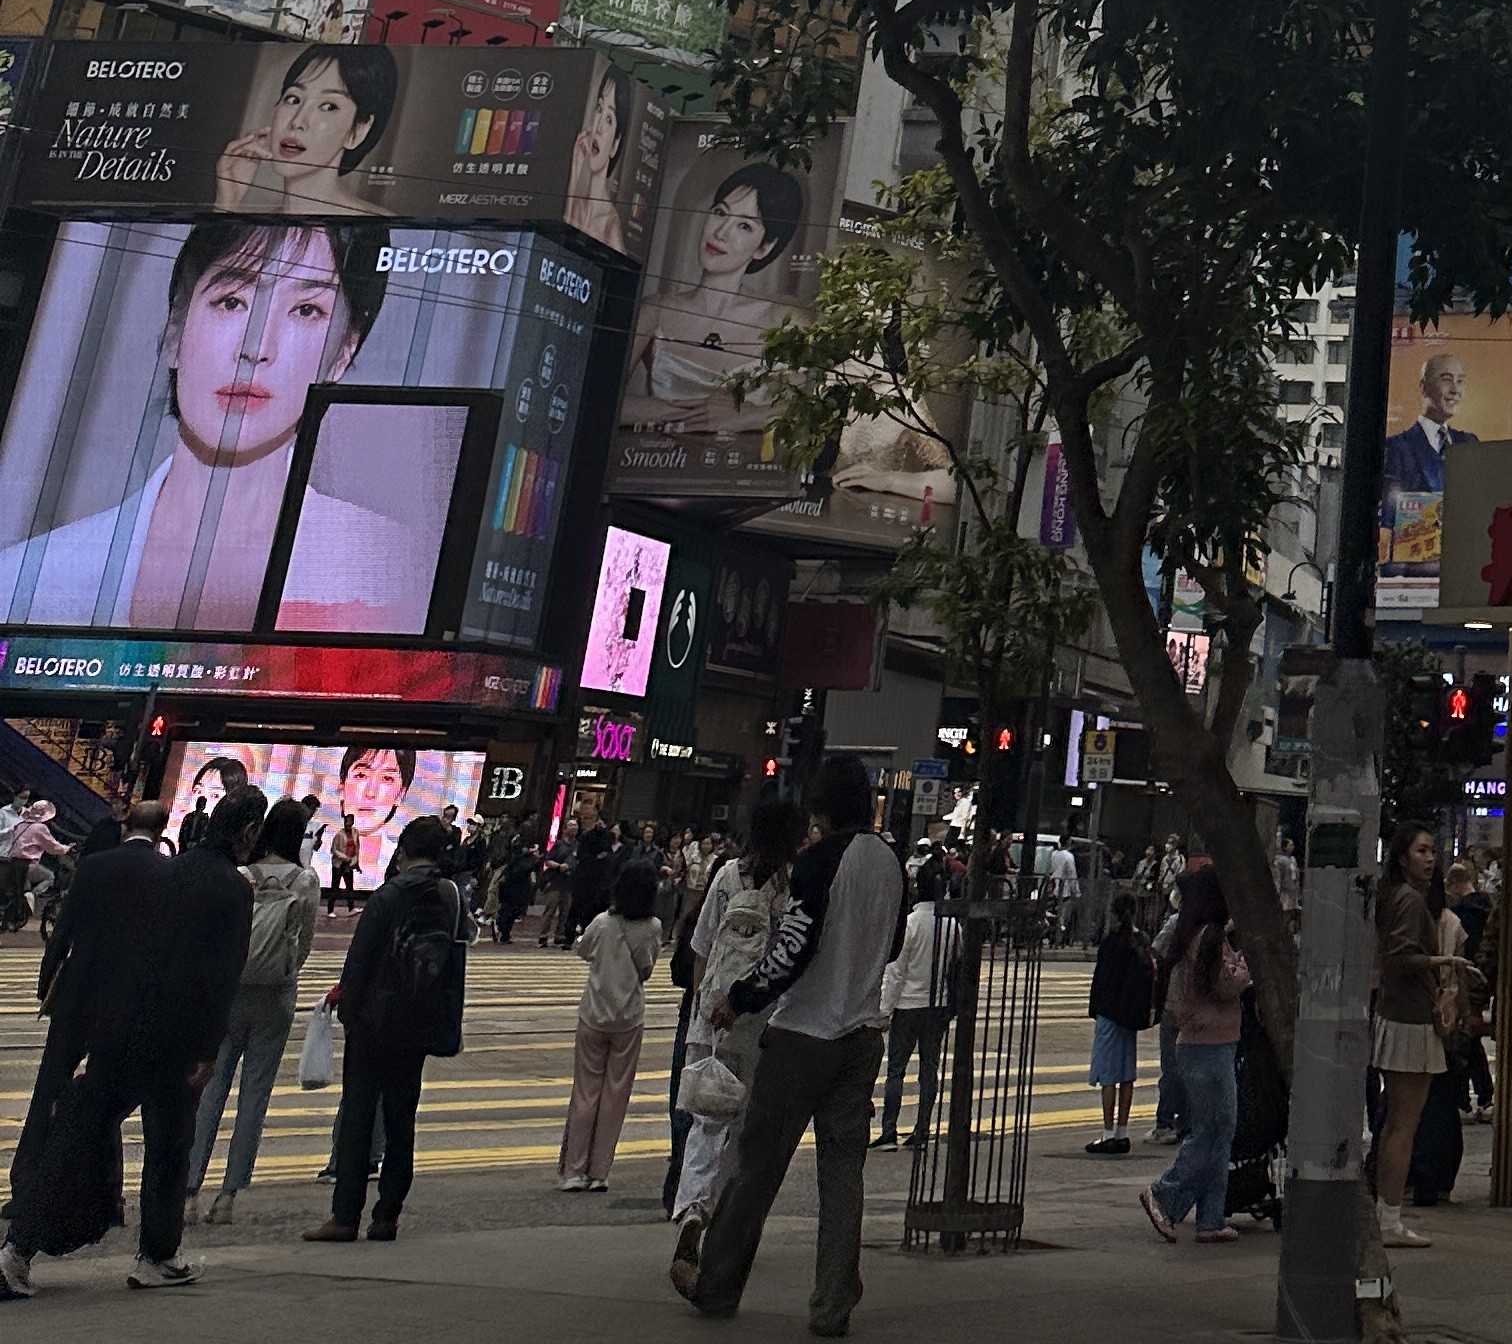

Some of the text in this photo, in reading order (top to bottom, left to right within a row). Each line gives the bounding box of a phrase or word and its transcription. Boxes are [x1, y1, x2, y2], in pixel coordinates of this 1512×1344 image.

[86, 60, 183, 80] BELOTERO
[52, 118, 152, 149] Nature
[74, 148, 176, 182] Details
[452, 162, 529, 176] 仿生透明質酸
[439, 193, 529, 206] MERZ AESTHETICS
[376, 247, 514, 275] BELOTERO
[620, 446, 688, 469] Smooth
[15, 657, 102, 677] BELOTERO
